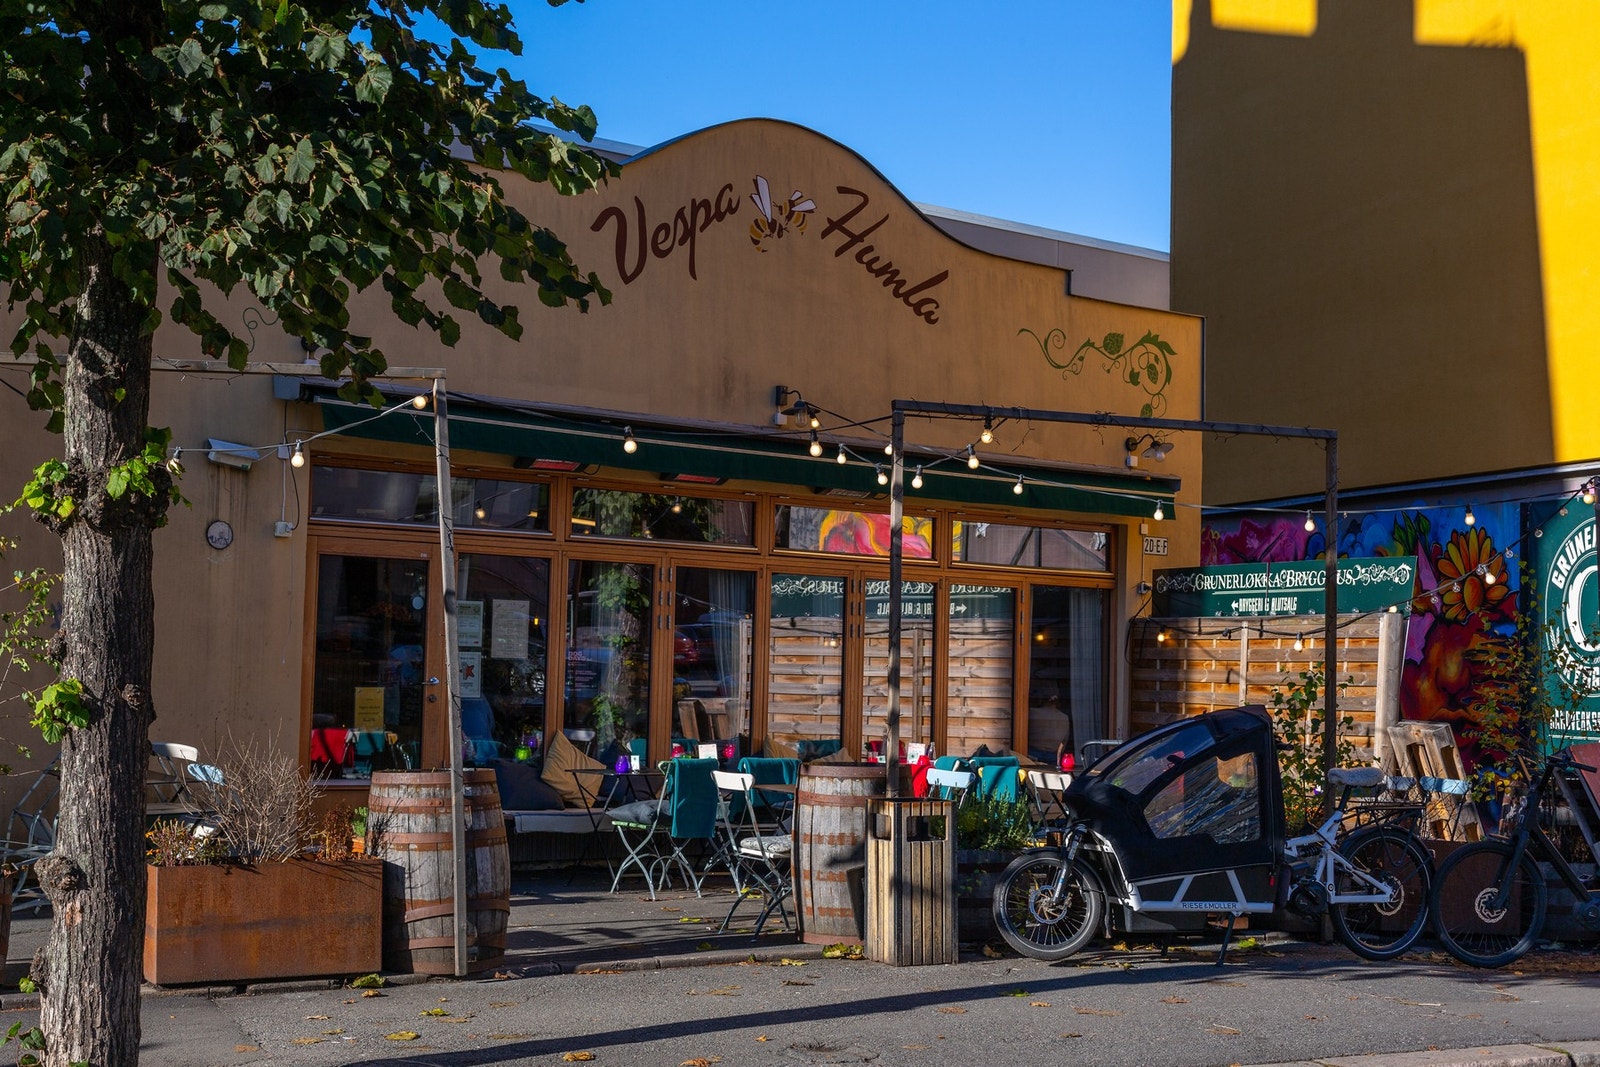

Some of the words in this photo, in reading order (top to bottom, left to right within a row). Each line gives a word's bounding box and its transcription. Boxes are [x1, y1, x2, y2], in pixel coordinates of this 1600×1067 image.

[590, 183, 740, 285] Vespa
[821, 186, 949, 325] Humla
[1286, 569, 1353, 587] BRYGGUS
